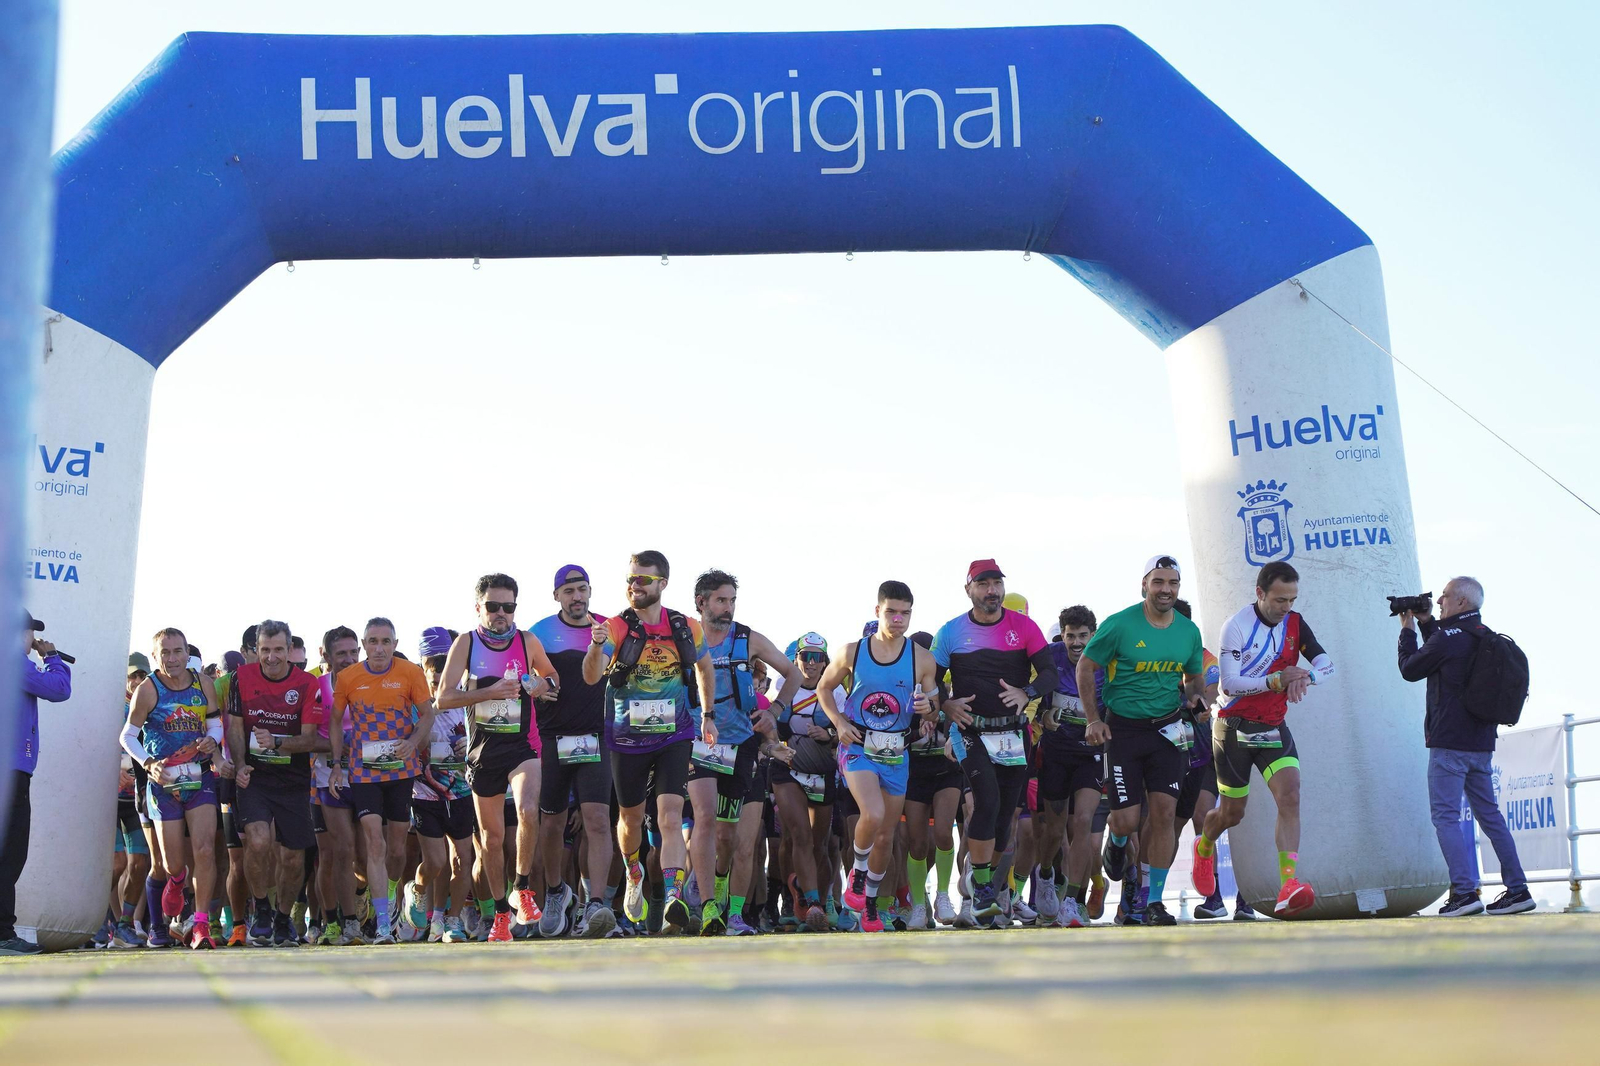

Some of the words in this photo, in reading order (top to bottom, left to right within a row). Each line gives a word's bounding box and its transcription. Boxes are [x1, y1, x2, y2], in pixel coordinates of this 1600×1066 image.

[301, 74, 648, 160] Huelva
[688, 65, 1021, 174] original
[1228, 405, 1379, 457] Huelva
[1335, 446, 1381, 462] original
[34, 479, 89, 496] original
[1303, 514, 1377, 530] Ayuntamiento
[1378, 513, 1389, 523] de
[1304, 527, 1391, 550] HUELVA
[69, 550, 82, 561] de
[1135, 660, 1184, 673] BIKILA
[490, 702, 508, 716] 98
[643, 702, 666, 715] 150
[866, 717, 893, 729] HUELVA
[877, 735, 899, 748] 149
[1113, 765, 1128, 803] BIKILA
[1506, 797, 1556, 831] HUELVA
